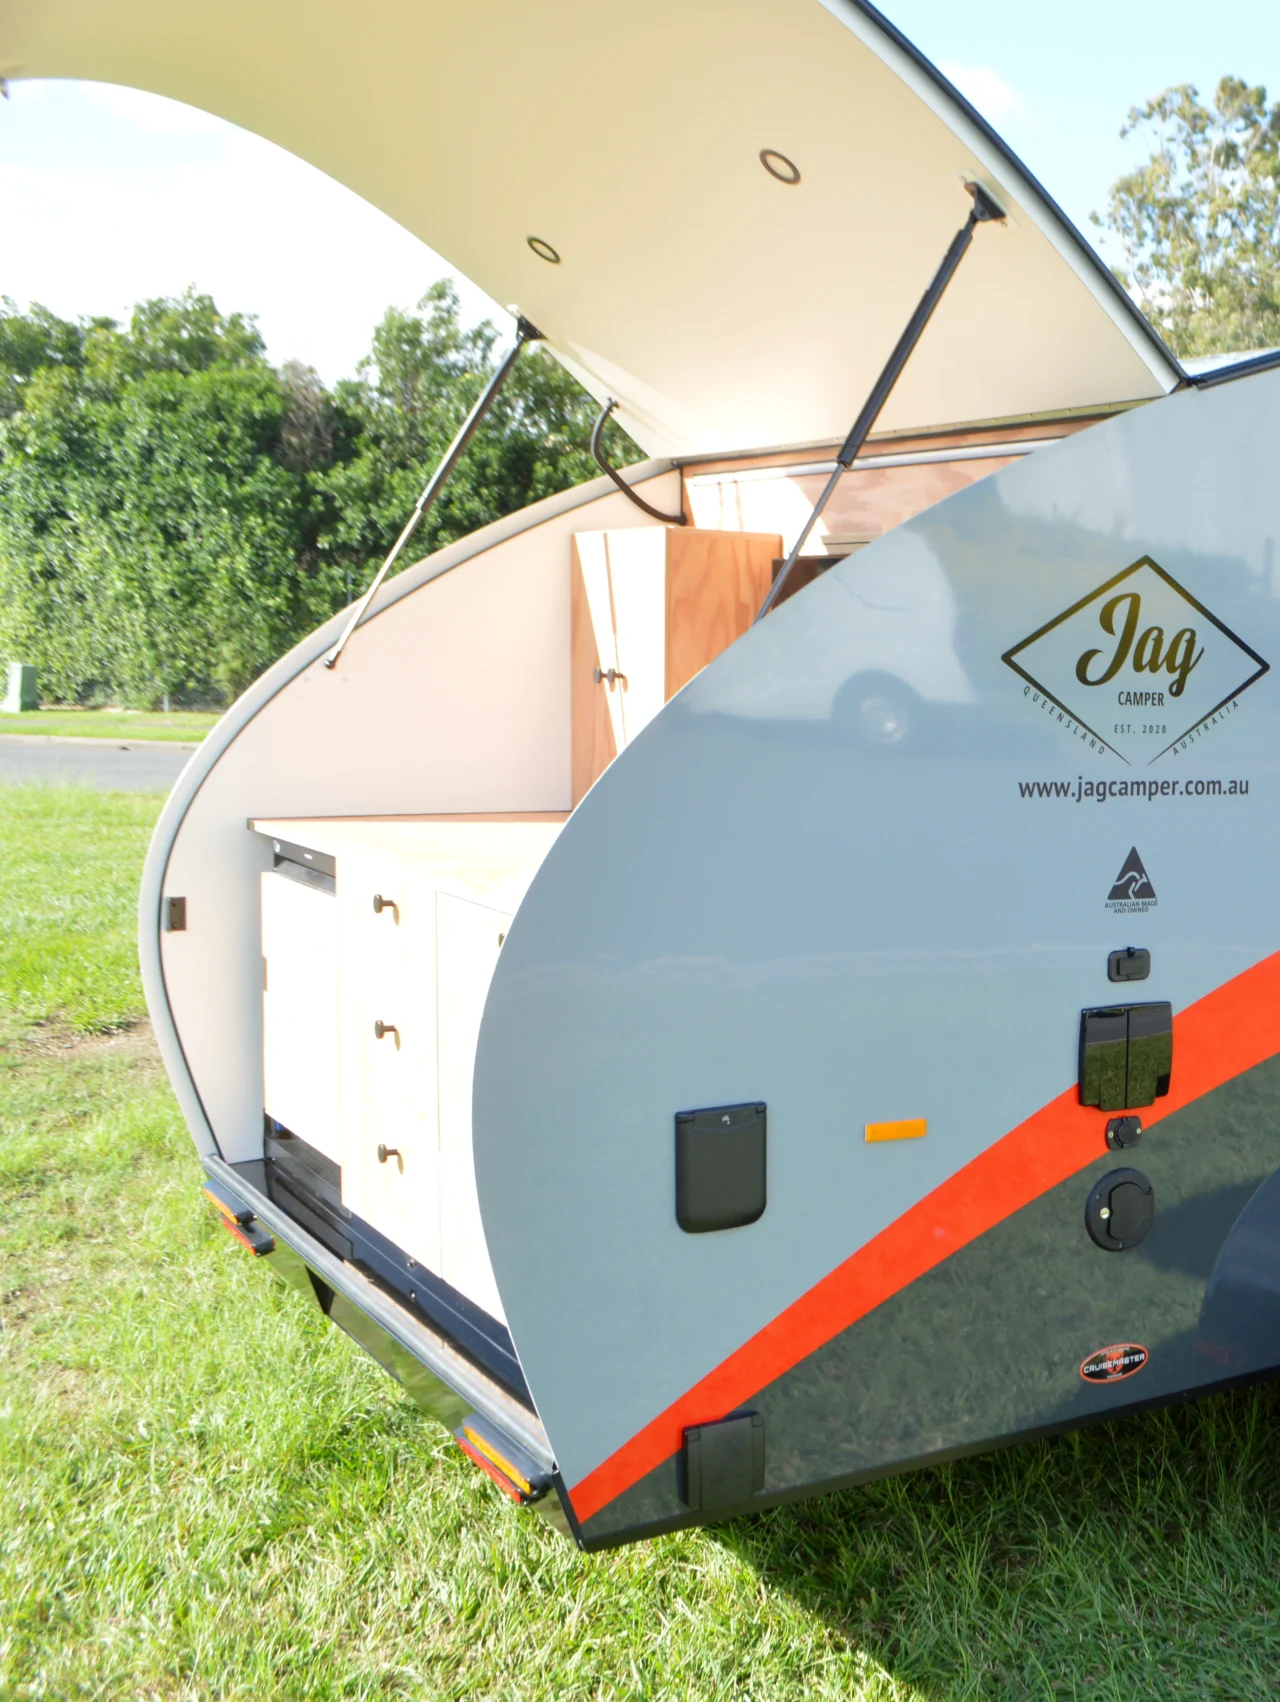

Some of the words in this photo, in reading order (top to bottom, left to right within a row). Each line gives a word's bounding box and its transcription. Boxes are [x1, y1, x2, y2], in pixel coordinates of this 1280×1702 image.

[1075, 592, 1205, 697] Jag
[1118, 691, 1165, 707] CAMPER
[1023, 685, 1105, 756] QUEENSLAND
[1114, 723, 1136, 734] EST.
[1142, 724, 1167, 734] 2020
[1172, 699, 1239, 756] AUSTRALIA
[1018, 775, 1250, 803] www.jagcamper.com.au
[1104, 901, 1140, 909] AUSTRALIAN
[1084, 1354, 1145, 1373] CRUISEMASTER
